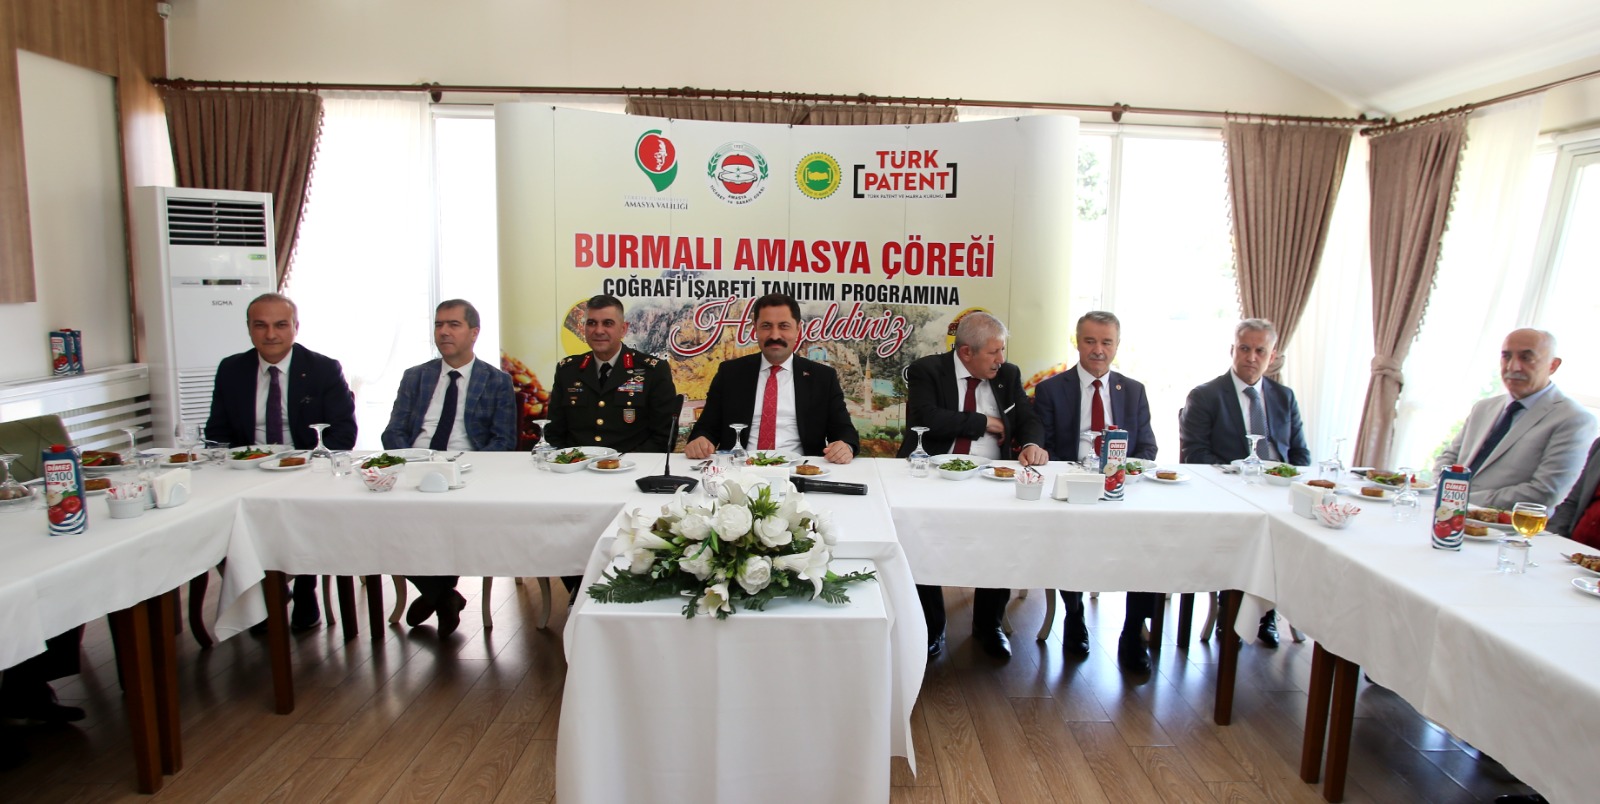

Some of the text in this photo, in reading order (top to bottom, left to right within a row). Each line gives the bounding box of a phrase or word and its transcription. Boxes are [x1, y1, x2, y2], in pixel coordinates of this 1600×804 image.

[876, 149, 939, 169] TÜRK
[864, 172, 950, 191] PATENT
[624, 201, 655, 209] AMASYA
[574, 232, 995, 280] BURMALI AMASYA ÇÖREĞİ
[603, 274, 960, 306] COĞRAFİ İŞARETİ TANITIM PROGRAMINA
